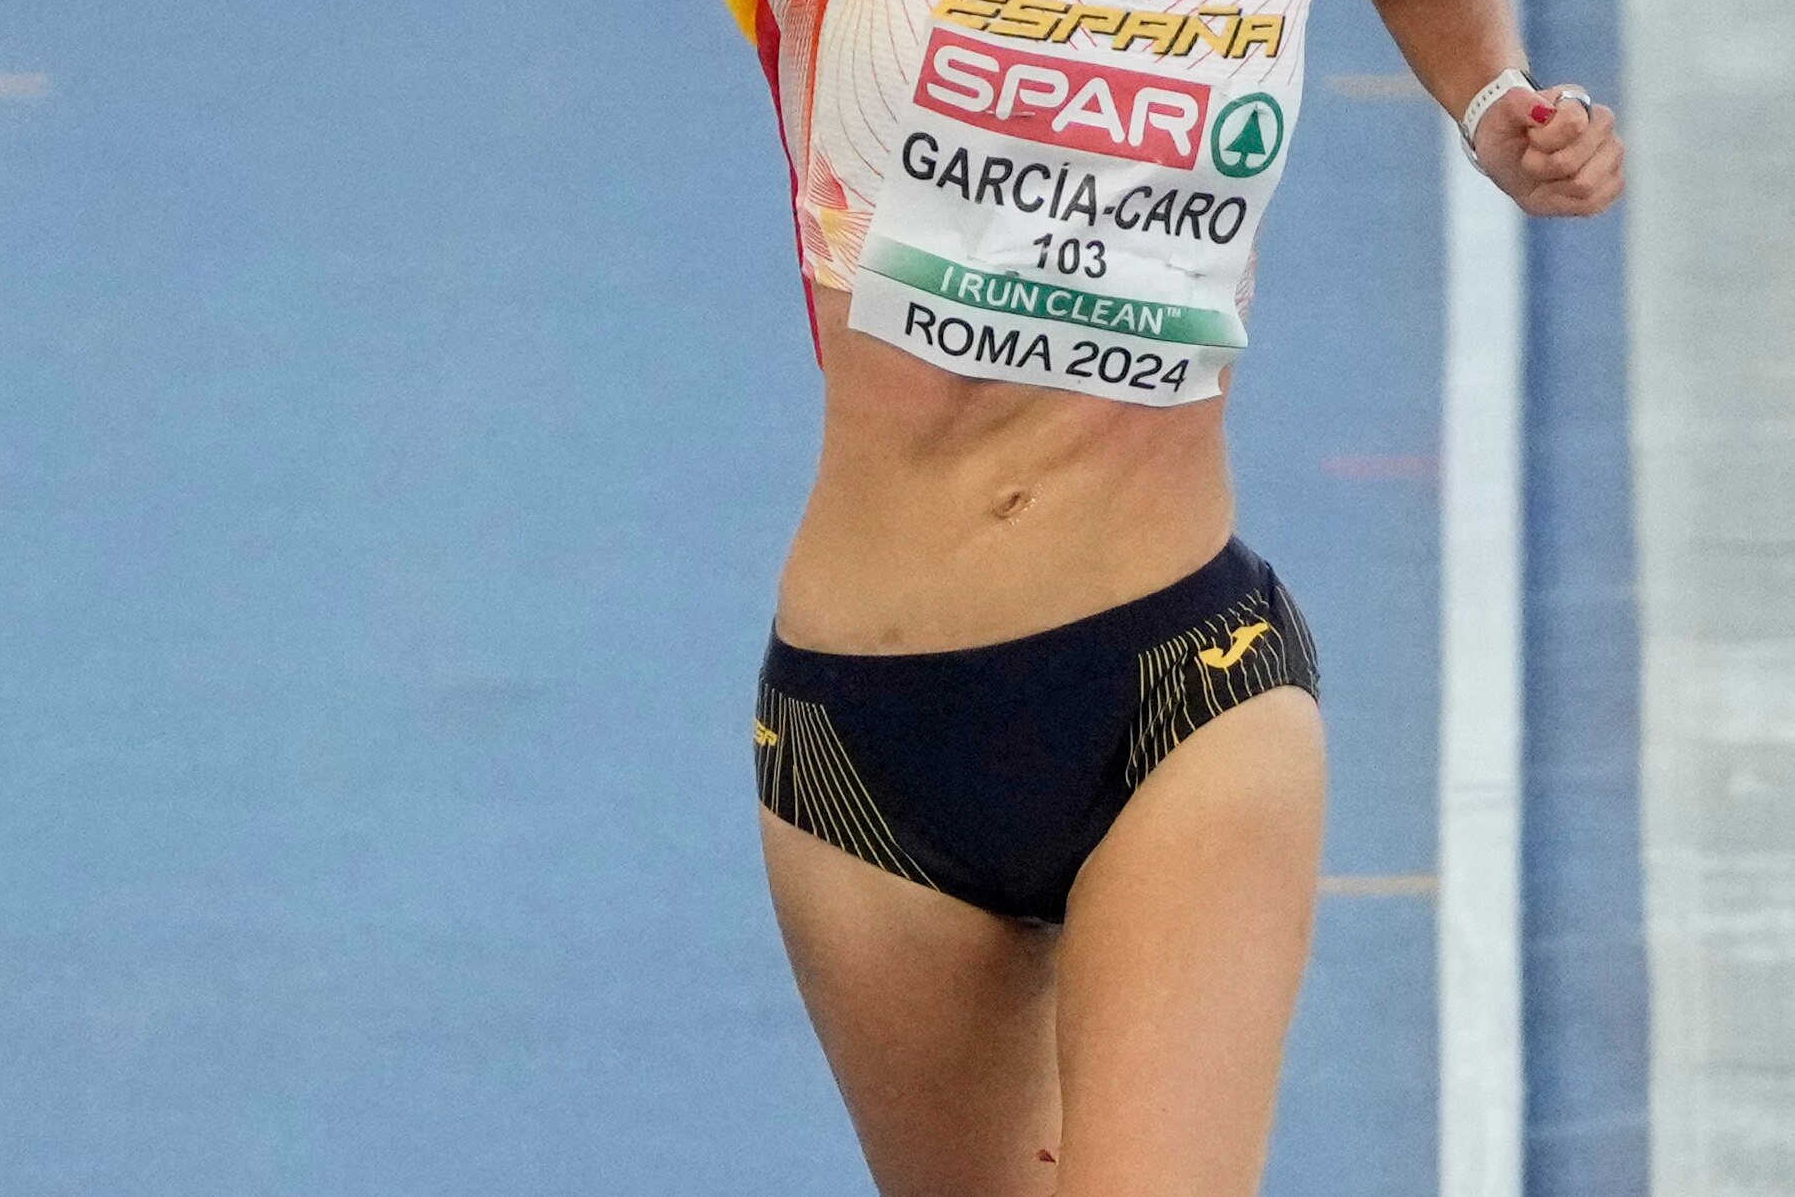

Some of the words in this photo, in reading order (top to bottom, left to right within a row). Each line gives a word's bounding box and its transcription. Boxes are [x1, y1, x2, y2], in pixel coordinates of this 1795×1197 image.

[926, 44, 1200, 157] SPAR
[902, 131, 1247, 245] GARCÍA-CARO
[940, 265, 954, 292] I
[957, 272, 1039, 313] RUN
[1033, 232, 1107, 279] 103
[904, 301, 1052, 372] ROMA
[1065, 340, 1190, 393] 2024
